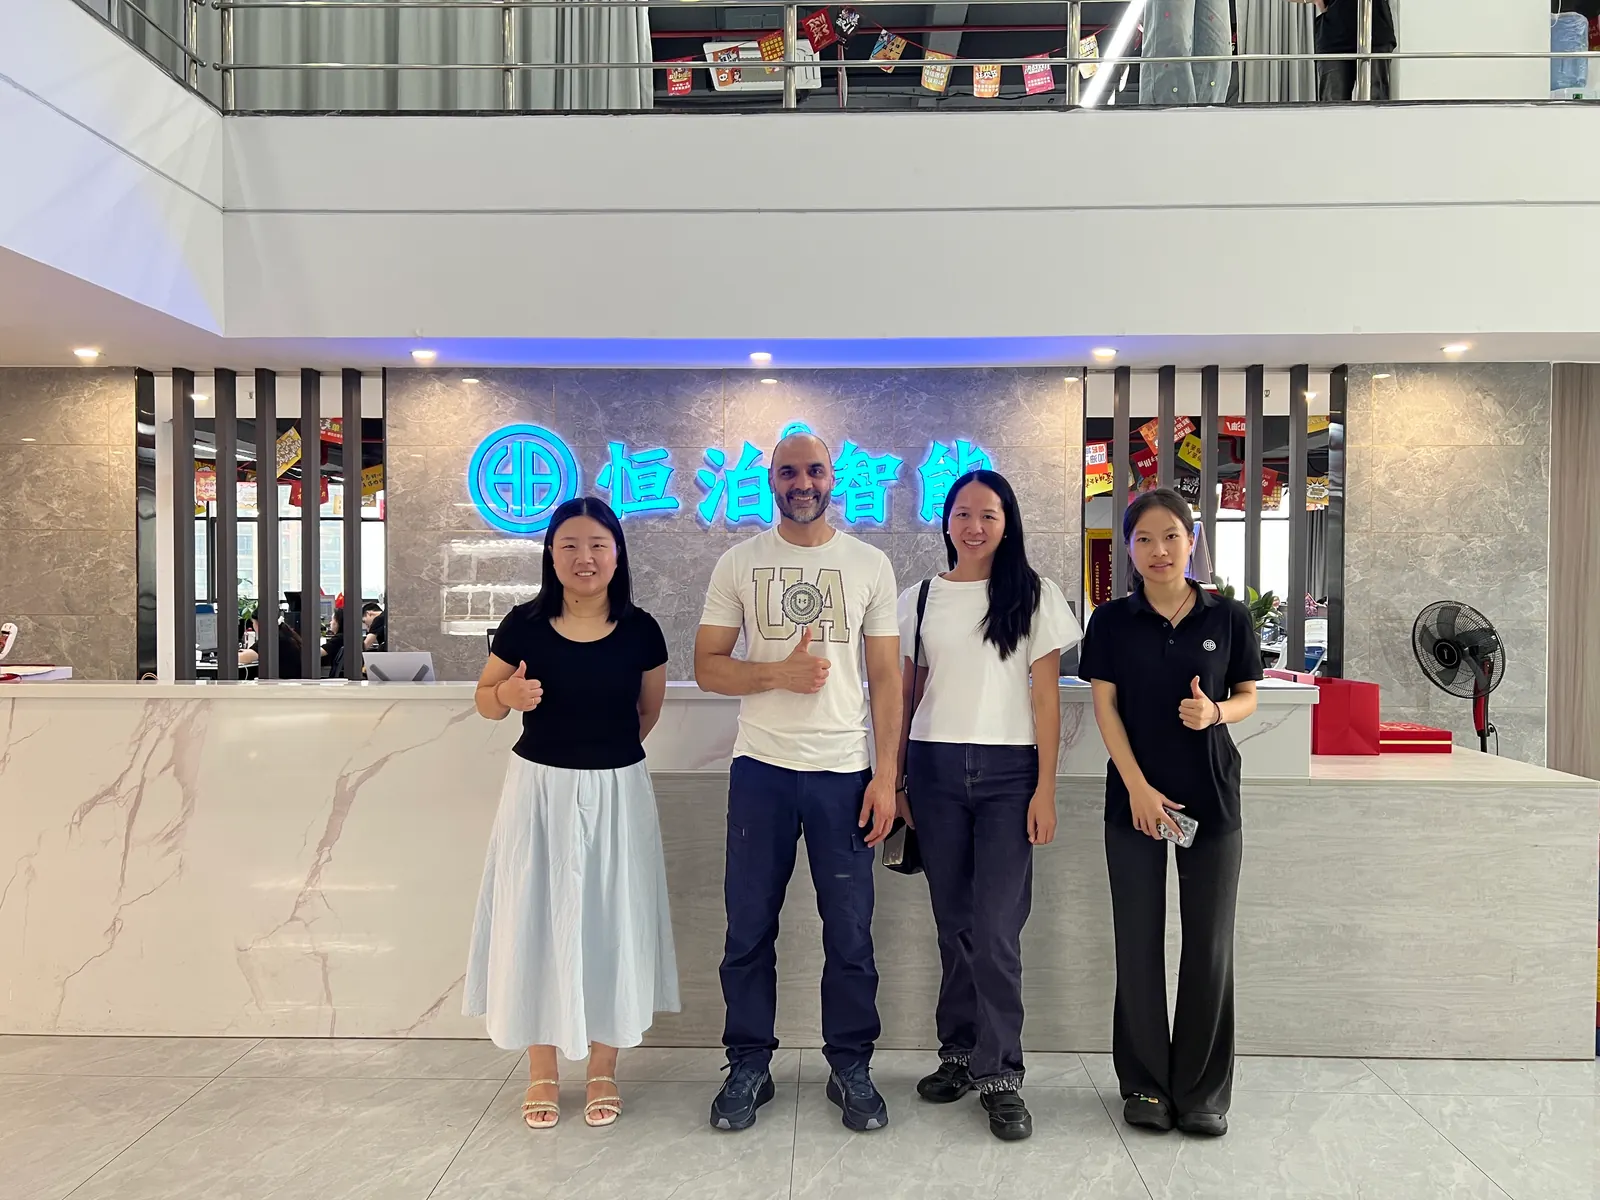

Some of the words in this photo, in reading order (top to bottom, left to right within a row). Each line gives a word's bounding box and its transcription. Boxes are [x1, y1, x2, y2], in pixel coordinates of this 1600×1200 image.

[596, 437, 992, 524] 恒泊智能
[752, 567, 850, 644] UA
